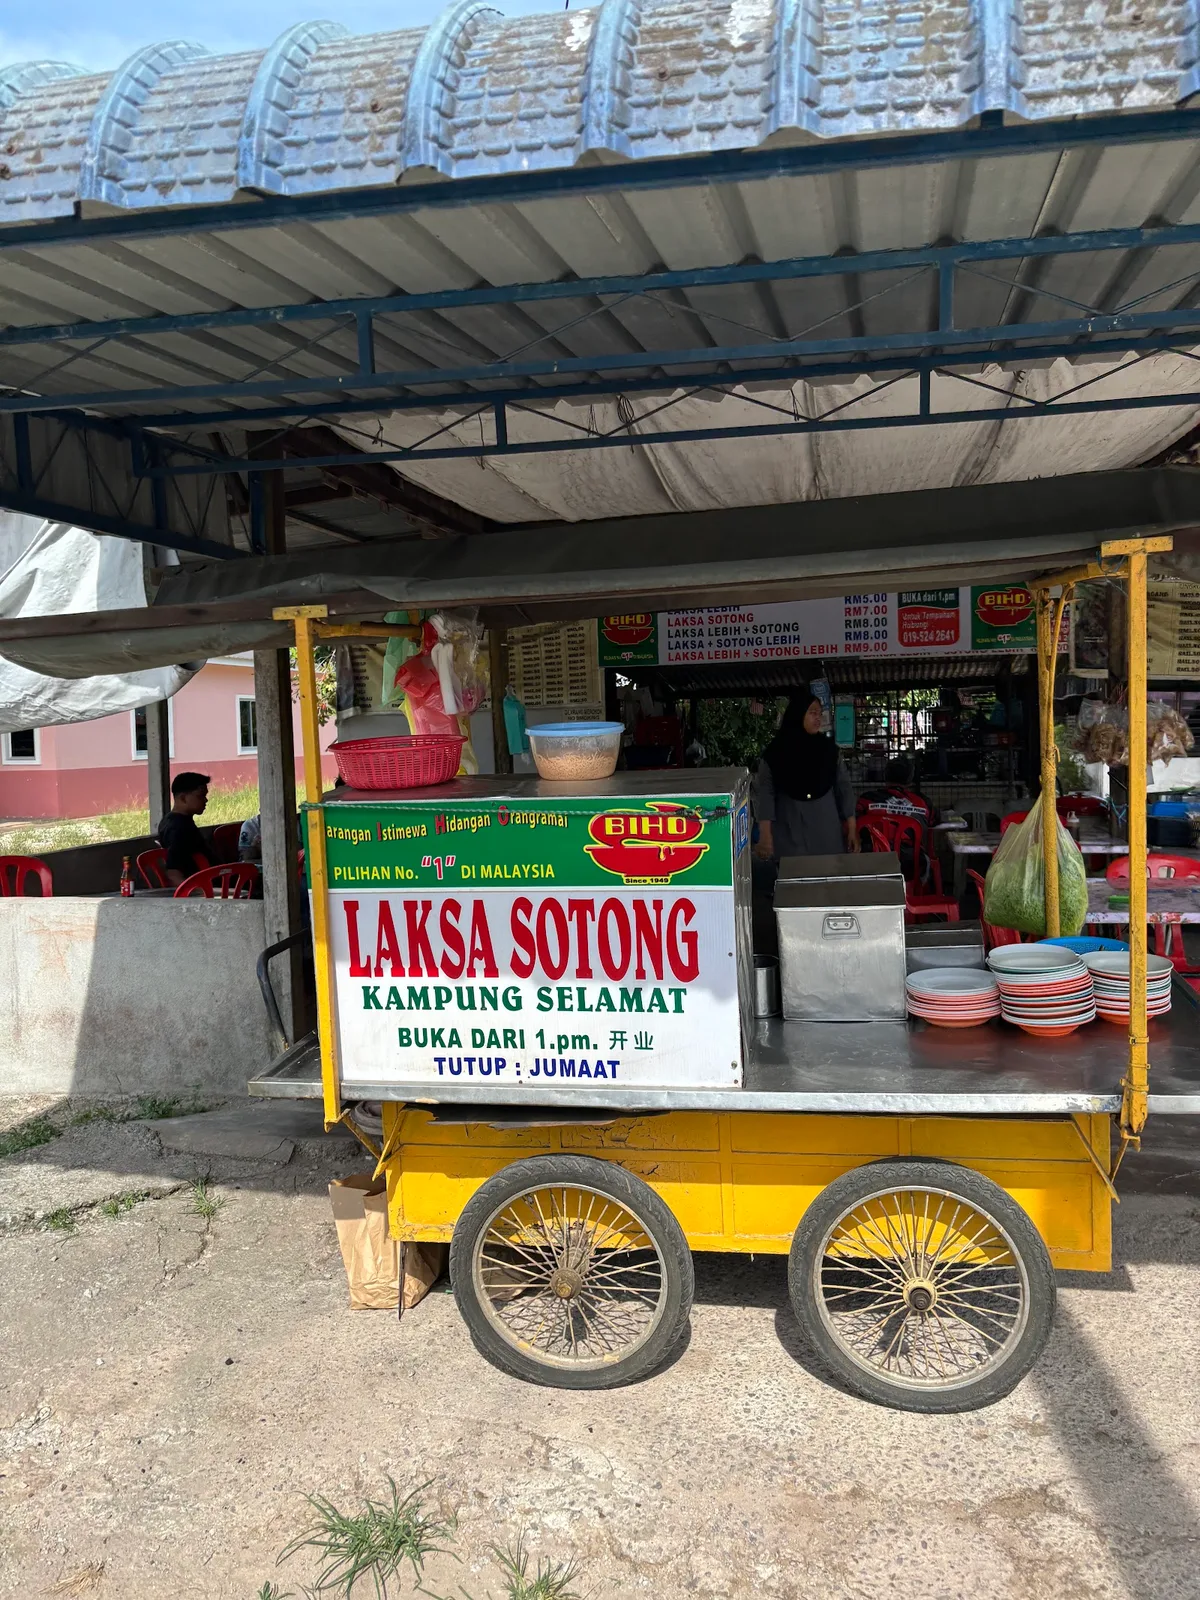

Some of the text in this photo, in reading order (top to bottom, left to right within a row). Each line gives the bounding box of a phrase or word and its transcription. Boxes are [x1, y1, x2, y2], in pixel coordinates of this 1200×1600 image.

[844, 592, 887, 604] RM5.00
[902, 593, 921, 603] BUKA
[922, 592, 936, 602] dari
[984, 593, 1025, 605] BIHO
[844, 605, 887, 617] RM7.00
[609, 614, 645, 625] BIHO
[668, 613, 754, 627] LAKSA SOTONG
[844, 617, 887, 629] RM8.00
[668, 628, 704, 638] LAKSA
[708, 626, 741, 637] LEBIH
[752, 622, 799, 634] SOTONG
[845, 630, 888, 641] RM8.00
[903, 630, 955, 643] 019-524 2641
[668, 640, 704, 650] LAKSA
[716, 636, 763, 648] SOTONG
[766, 635, 800, 645] LEBIH
[844, 642, 887, 653] RM9.00
[668, 651, 704, 662] LAKSA
[707, 649, 741, 660] LEBIH
[753, 646, 800, 658] SOTONG
[803, 644, 838, 655] LEBIH
[326, 805, 568, 845] arangan Istimewa Hidangan Orangramai
[604, 816, 687, 836] BIHO
[334, 866, 391, 881] PILIHAN
[395, 866, 419, 880] No.
[461, 865, 476, 879] DI
[481, 864, 555, 879] MALAYSIA
[343, 896, 700, 983] LAKSA SOTONG
[361, 985, 687, 1014] KAMPUNG SELAMAT
[398, 1027, 599, 1055] BUKA DARI 1.pm.
[434, 1056, 507, 1077] TUTUP
[529, 1058, 620, 1079] JUMAAT
